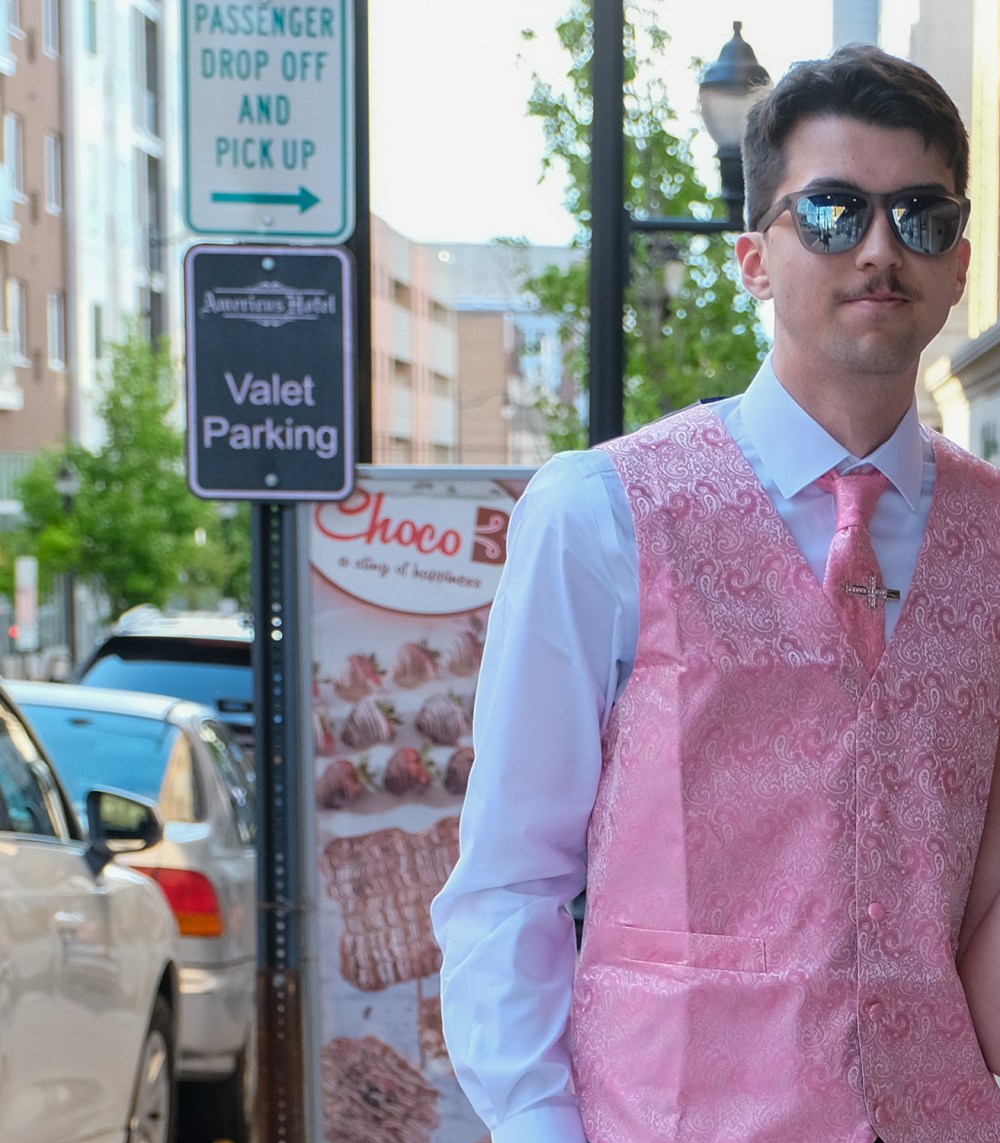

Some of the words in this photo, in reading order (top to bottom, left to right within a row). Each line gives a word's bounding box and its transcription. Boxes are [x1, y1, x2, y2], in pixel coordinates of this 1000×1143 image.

[194, 6, 334, 37] PASSENGER
[202, 49, 269, 80] DROP
[282, 52, 328, 82] OFF
[239, 95, 291, 125] AND
[216, 138, 273, 169] PICK
[283, 141, 316, 169] UP
[286, 293, 335, 316] Hotel
[224, 372, 316, 406] Valet
[203, 416, 338, 459] Parking
[315, 488, 462, 557] Choco
